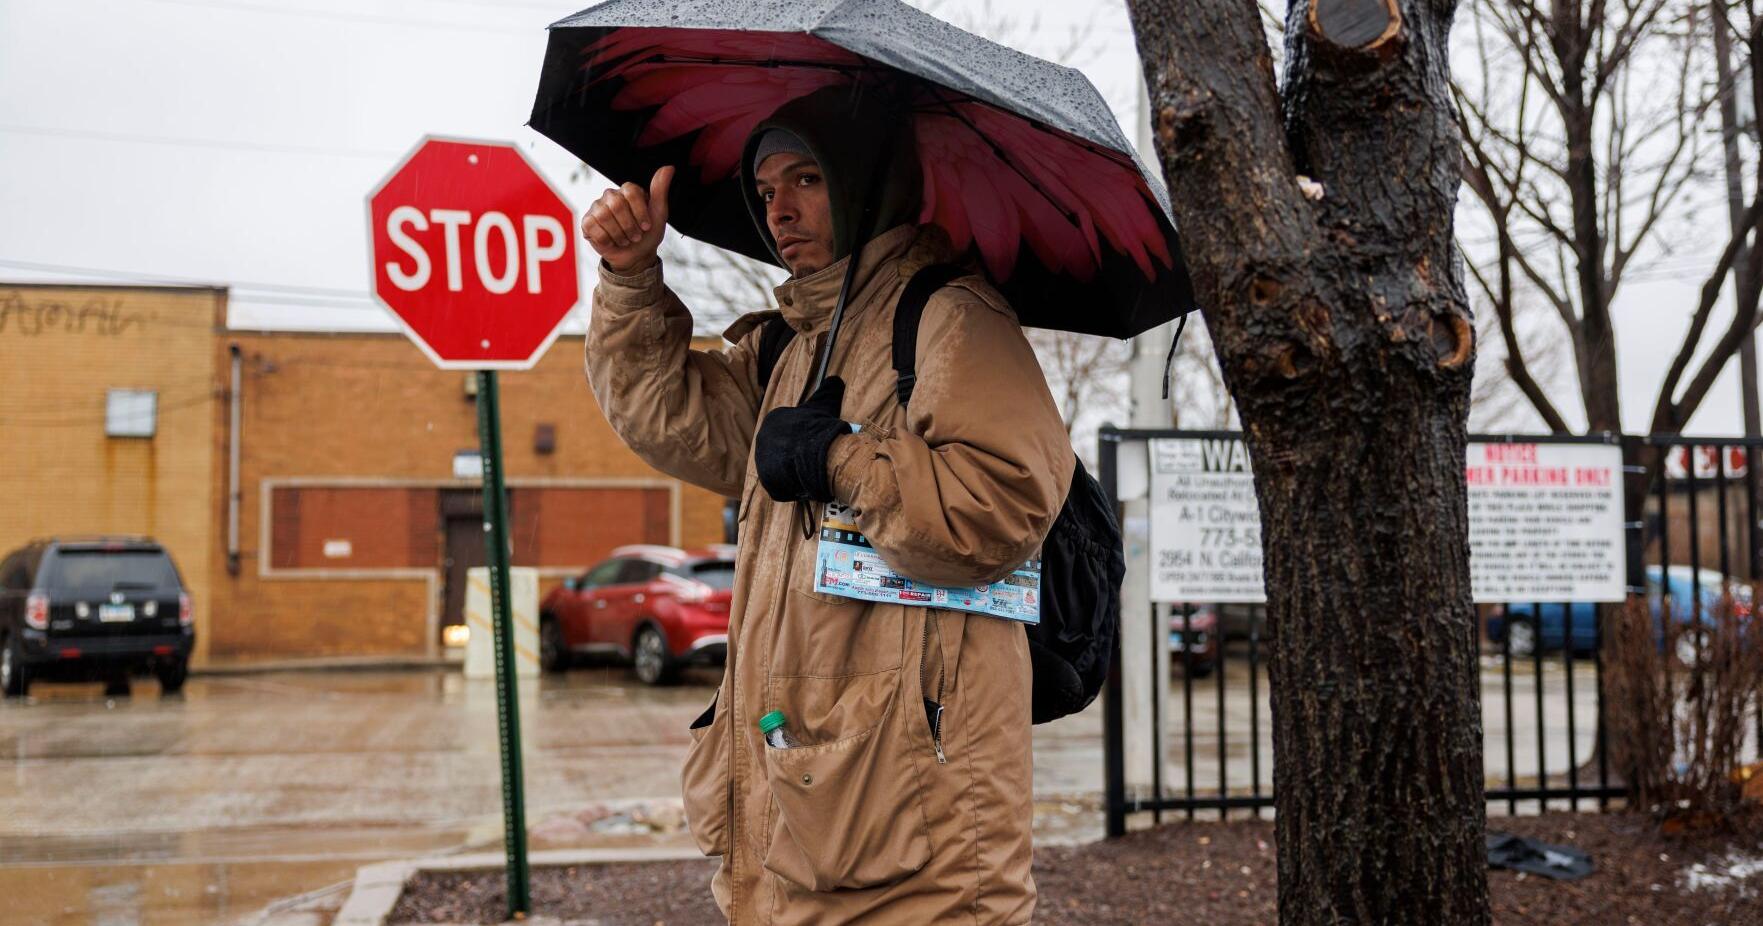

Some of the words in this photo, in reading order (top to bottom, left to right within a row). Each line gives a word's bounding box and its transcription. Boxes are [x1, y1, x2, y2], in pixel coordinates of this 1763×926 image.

[385, 205, 567, 294] STOP
[1201, 438, 1251, 472] WA
[1485, 444, 1538, 463] NOTICE
[1467, 466, 1494, 485] MER
[1502, 466, 1568, 485] PARKING
[1575, 466, 1611, 485] ONLY
[1200, 527, 1261, 547] 773-5
